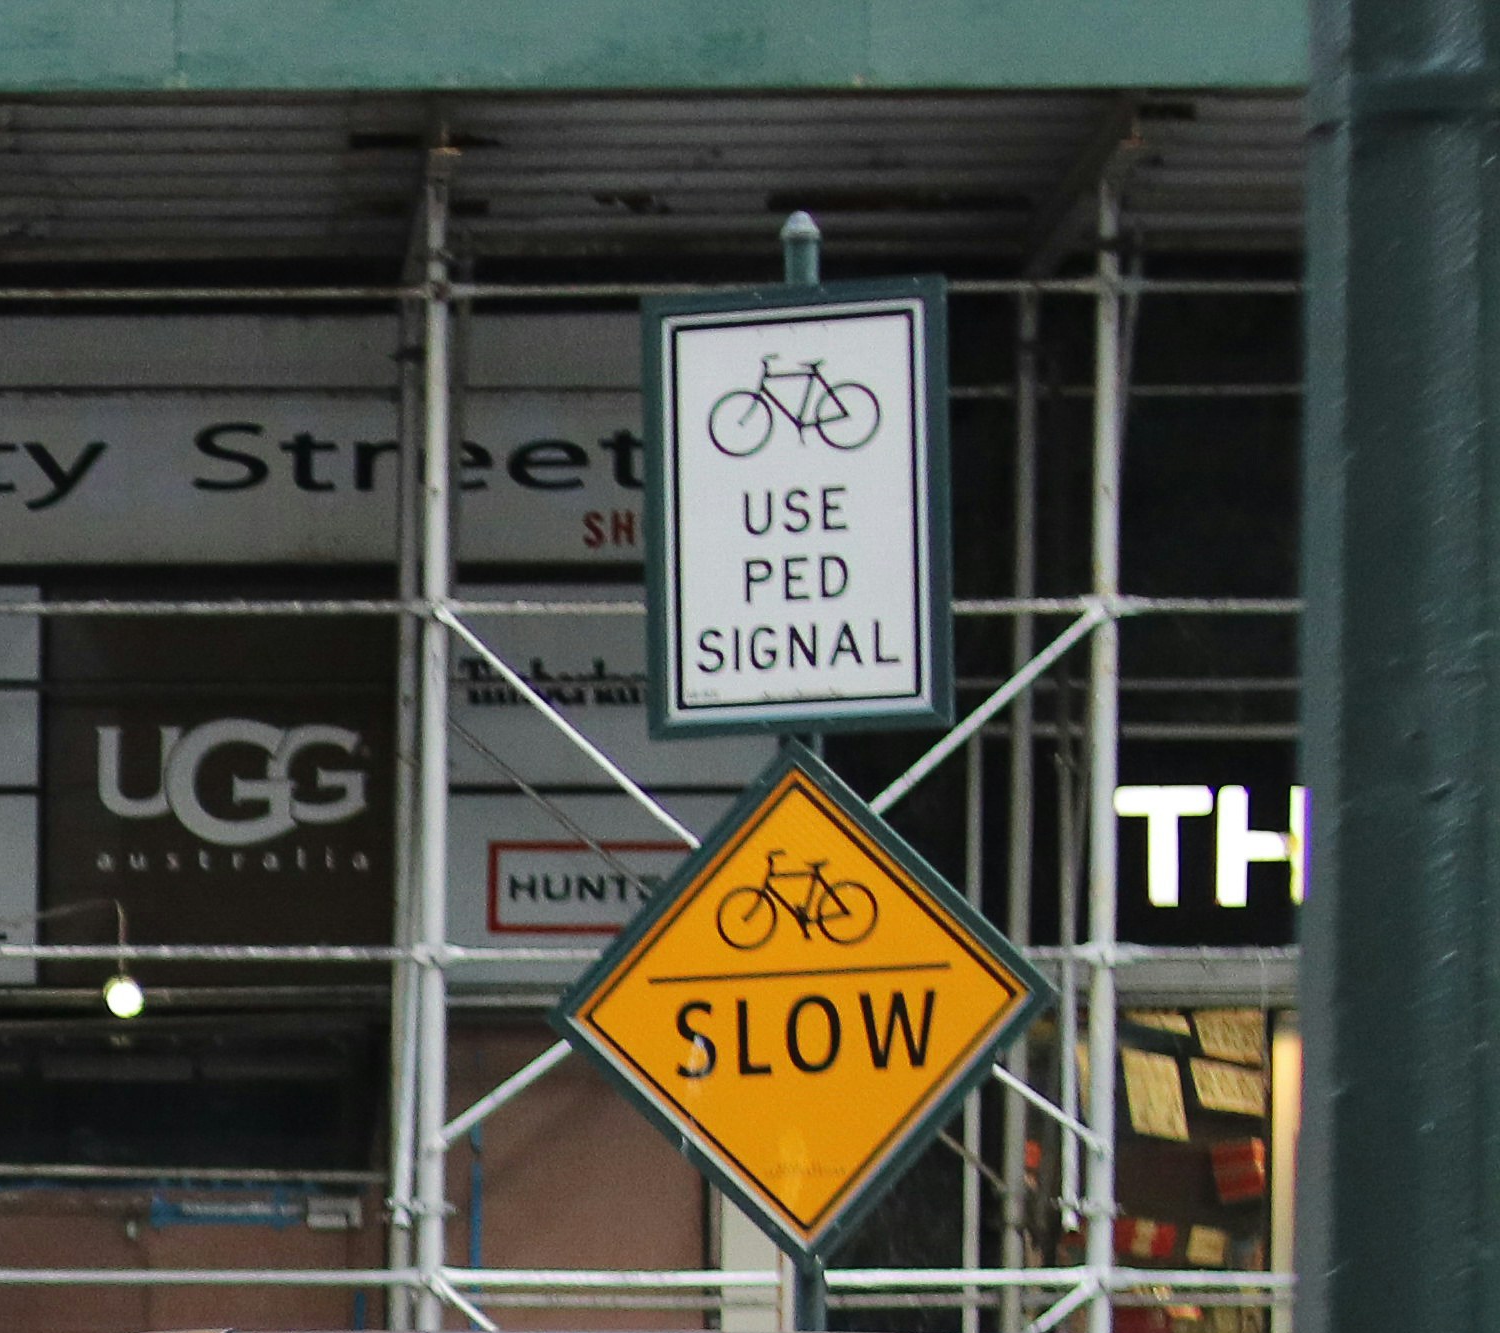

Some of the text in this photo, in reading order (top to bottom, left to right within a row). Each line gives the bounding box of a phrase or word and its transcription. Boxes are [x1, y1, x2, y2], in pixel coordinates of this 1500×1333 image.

[582, 511, 636, 548] SH
[742, 487, 849, 538] USE
[743, 553, 849, 604] PED
[696, 620, 902, 674] SIGNAL
[96, 716, 367, 847] UGG
[97, 846, 370, 872] australia
[1113, 784, 1311, 908] TH
[508, 872, 650, 902] HUNT
[674, 990, 938, 1080] SLOW
